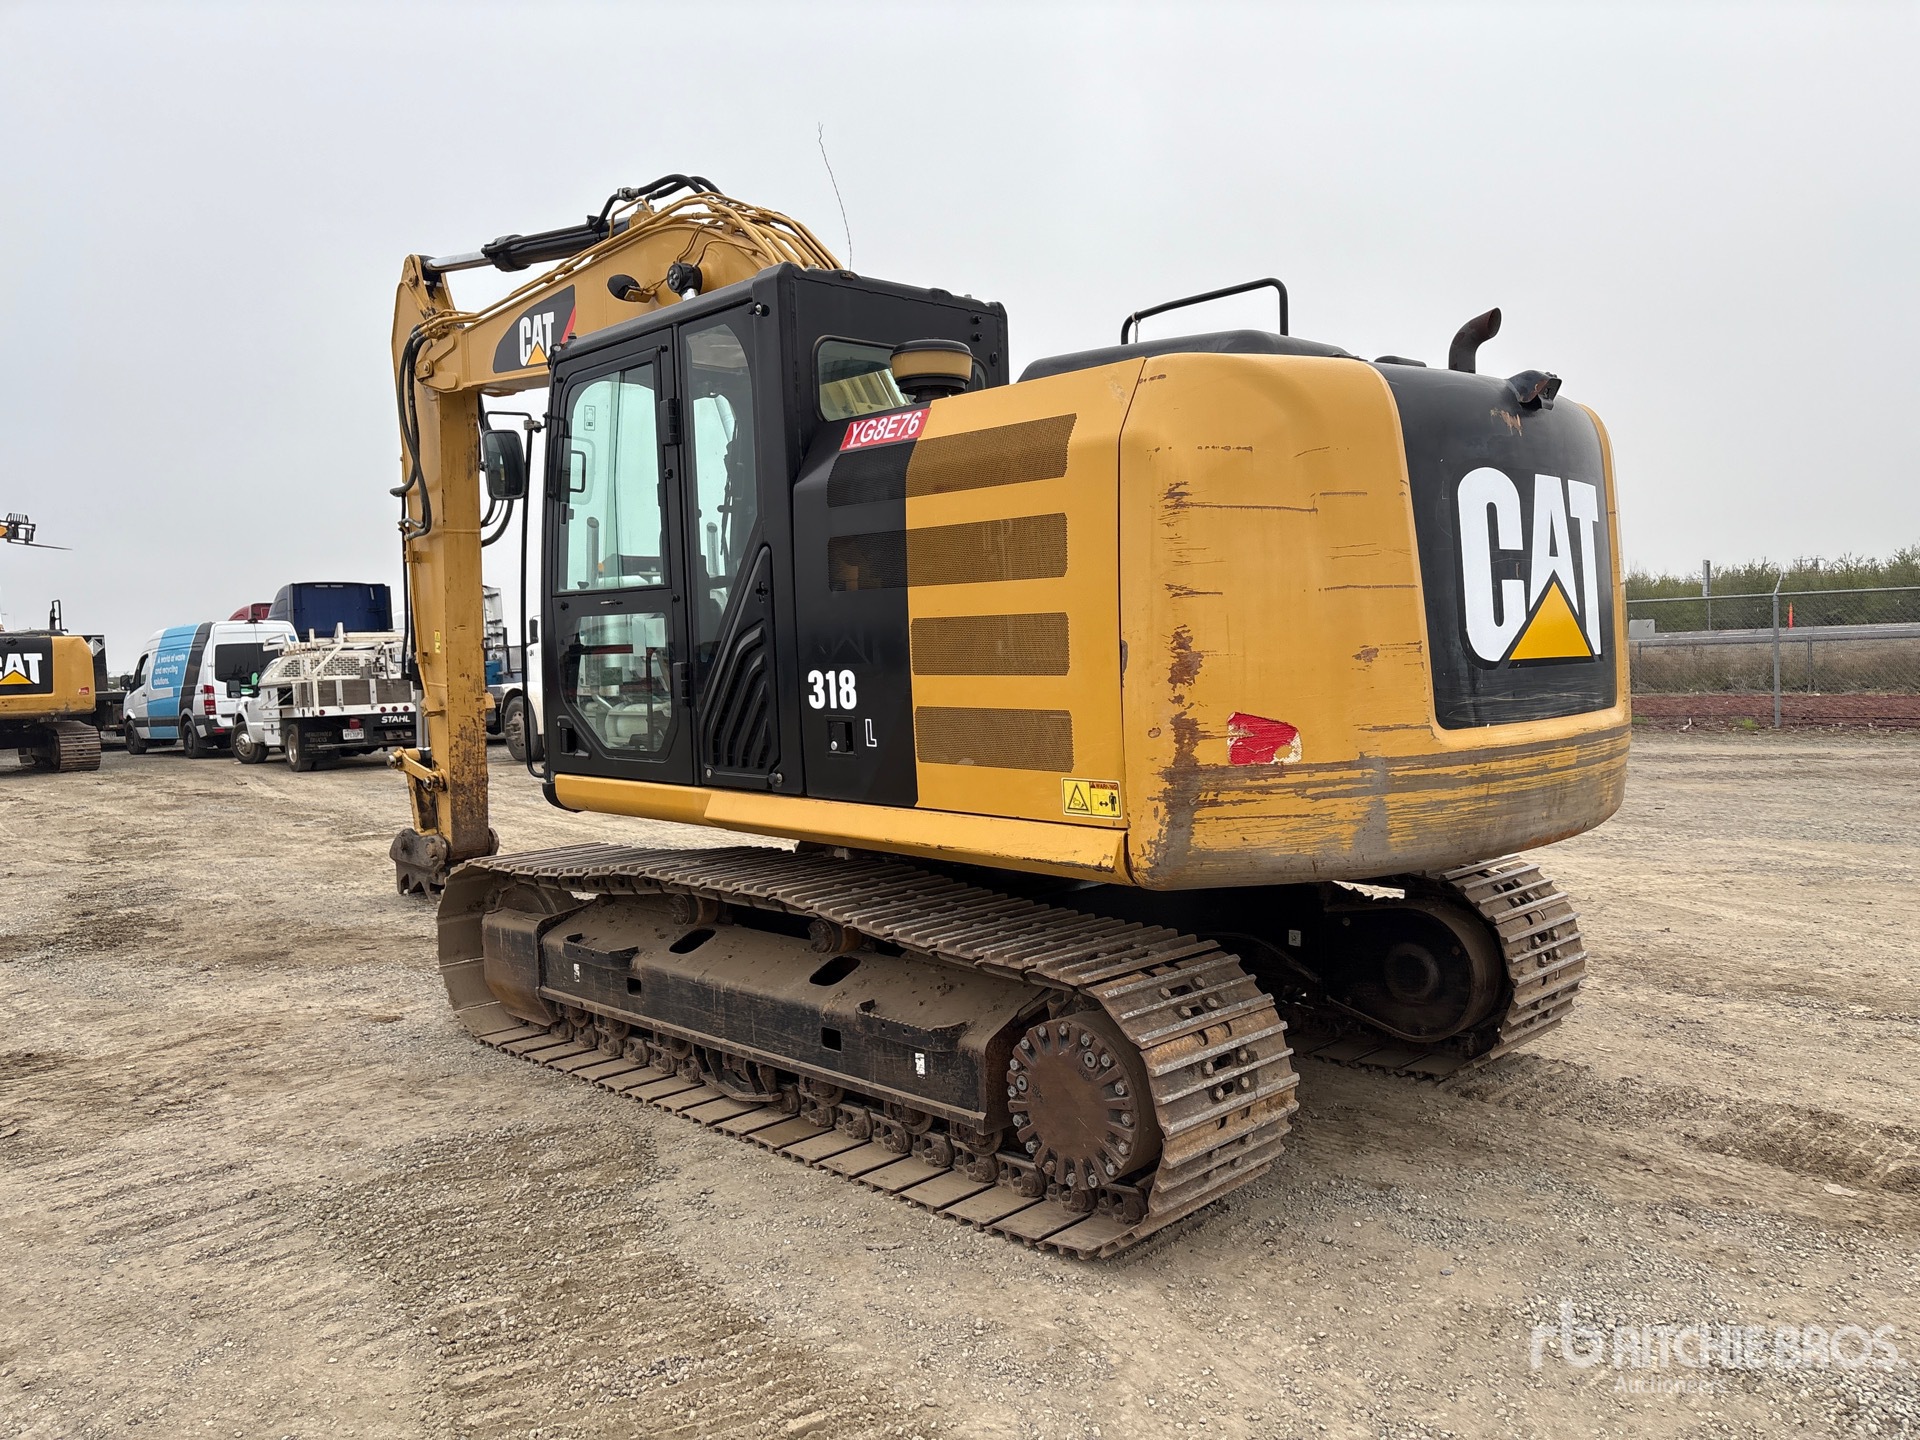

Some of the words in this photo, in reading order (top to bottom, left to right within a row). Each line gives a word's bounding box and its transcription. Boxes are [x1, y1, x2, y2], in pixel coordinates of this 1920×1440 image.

[519, 311, 555, 367] CAT
[850, 411, 922, 446] YG8E76
[1457, 466, 1602, 662] CAT
[0, 653, 42, 684] AT
[808, 669, 857, 710] 318
[381, 715, 411, 723] STAHL
[865, 718, 877, 747] L
